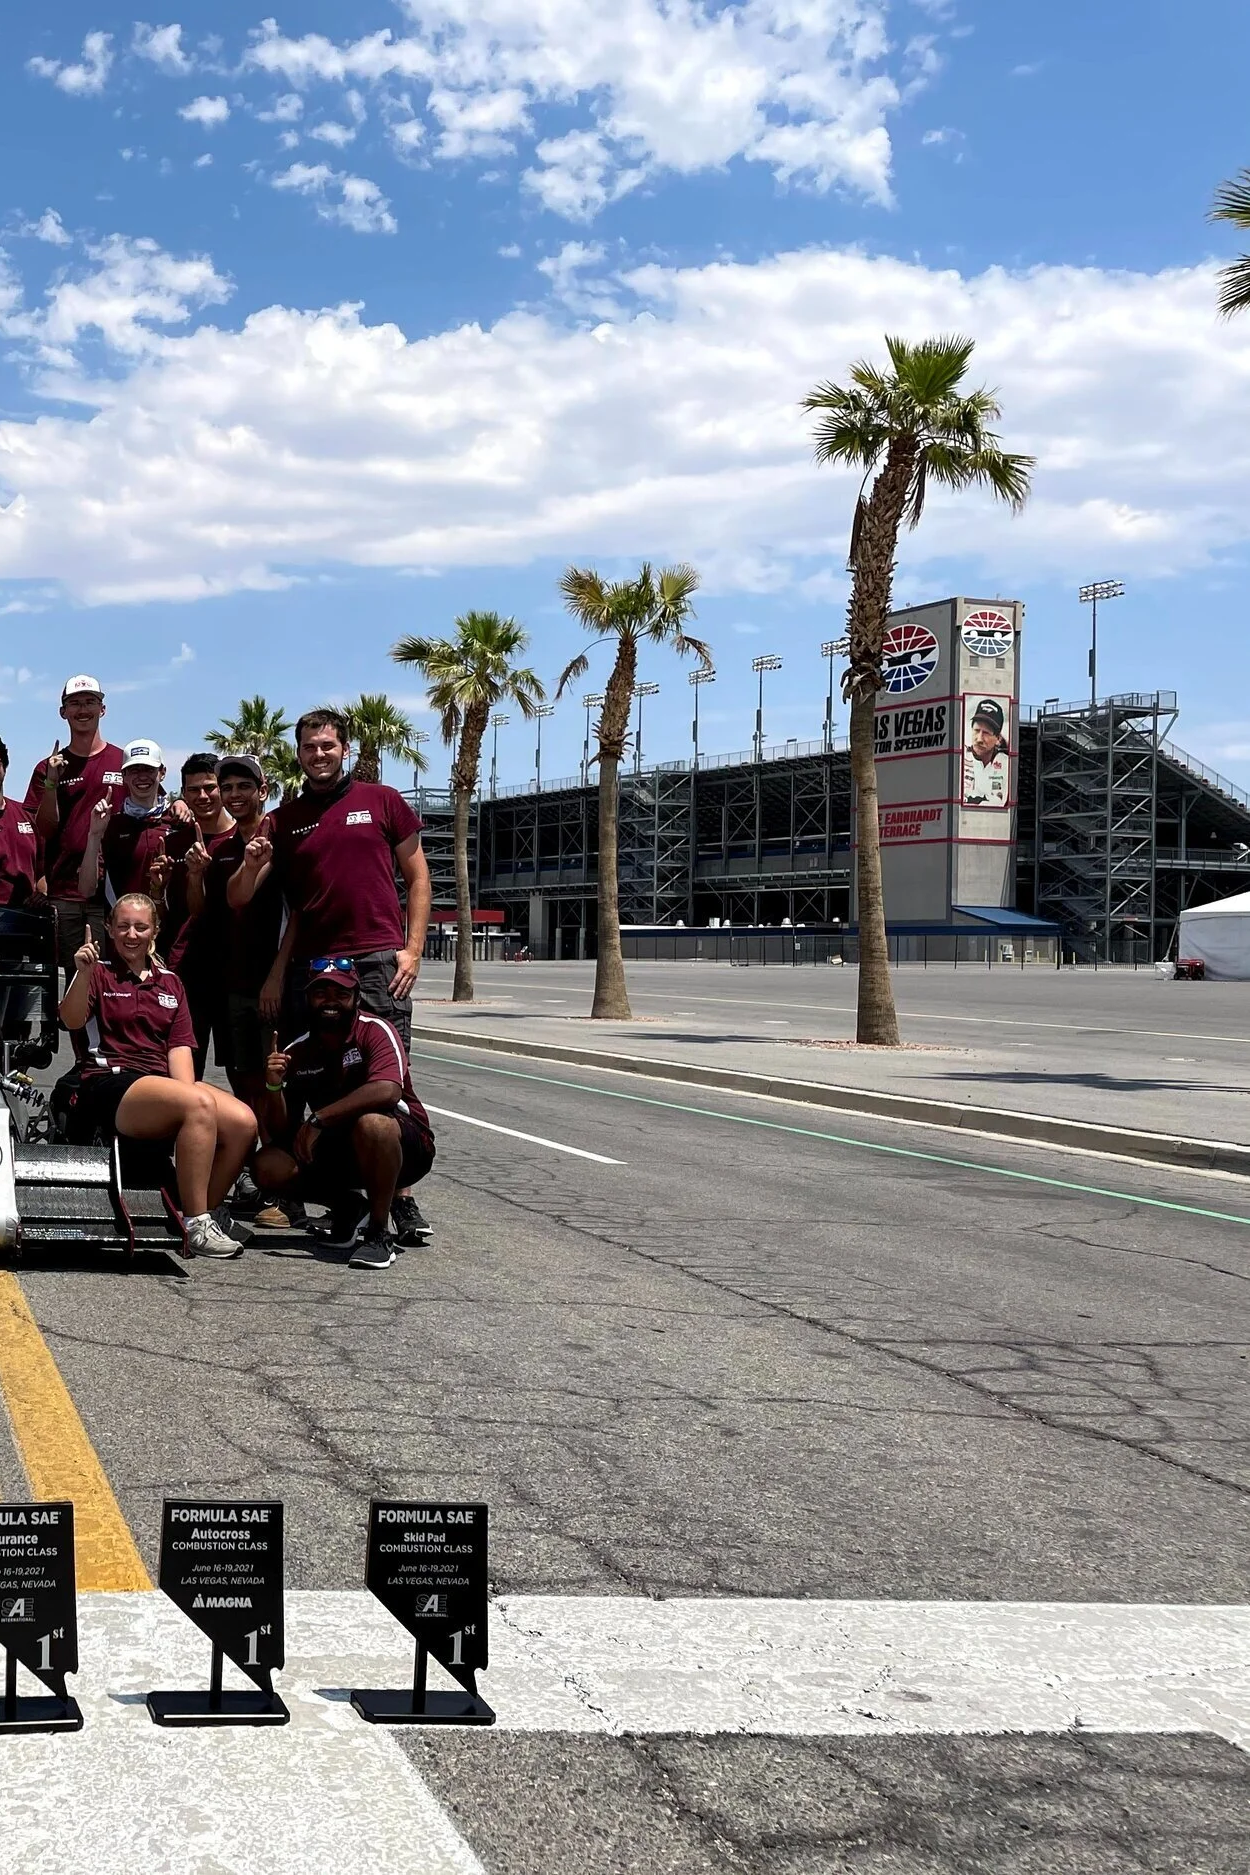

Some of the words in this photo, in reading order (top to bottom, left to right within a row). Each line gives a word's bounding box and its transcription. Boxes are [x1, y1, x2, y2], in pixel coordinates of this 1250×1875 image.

[894, 705, 947, 738] VEGAS
[874, 740, 892, 754] TOR
[893, 732, 947, 752] SPEEDWAY
[884, 808, 943, 825] EARNHARDT
[878, 823, 922, 838] TERRACE
[30, 1511, 59, 1525] SAE
[171, 1509, 238, 1523] FORMULA
[241, 1509, 270, 1523] SAE
[378, 1510, 443, 1523] FORMULA
[446, 1511, 474, 1524] SAE
[191, 1528, 251, 1540] Autocross
[403, 1532, 425, 1542] Skid
[427, 1533, 446, 1542] Pad
[172, 1541, 235, 1550] COMBUSTION
[237, 1541, 268, 1550] CLASS
[379, 1544, 441, 1553] COMBUSTION
[443, 1545, 473, 1553] CLASS
[27, 1547, 58, 1556] CLASS
[192, 1564, 211, 1572] June
[21, 1580, 56, 1588] NEVADA
[180, 1577, 197, 1585] LAS
[230, 1577, 265, 1585] NEVADA
[387, 1577, 403, 1585] LAS
[436, 1577, 470, 1585] NEVADA
[206, 1597, 252, 1608] MAGNA
